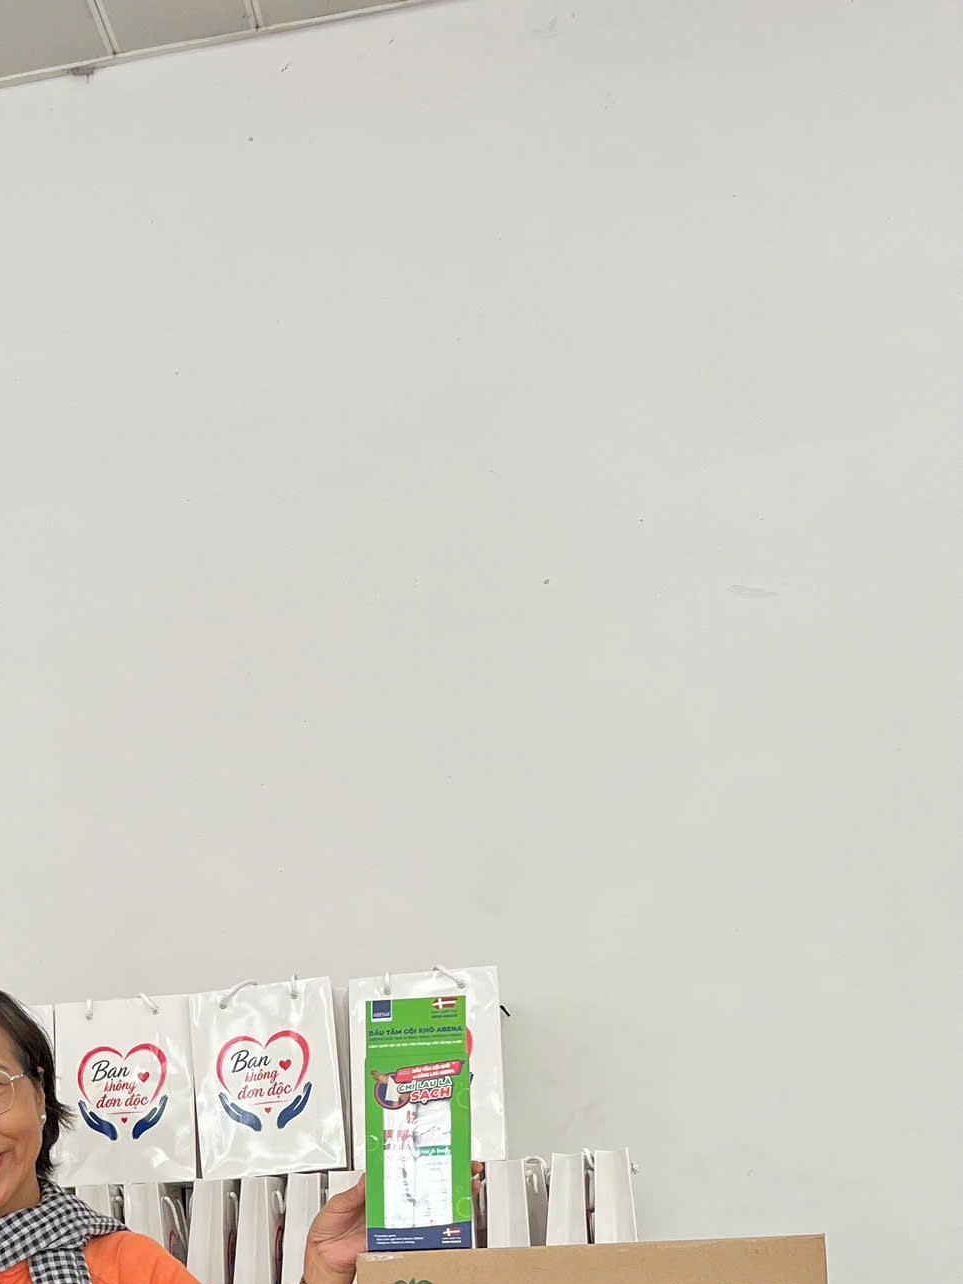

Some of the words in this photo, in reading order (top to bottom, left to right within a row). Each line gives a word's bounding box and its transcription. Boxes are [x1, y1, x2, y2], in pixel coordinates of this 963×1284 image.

[231, 1049, 271, 1073] Bạn
[92, 1060, 131, 1082] Bạn
[245, 1070, 279, 1083] không
[104, 1080, 136, 1094] không
[238, 1085, 264, 1100] đơn
[267, 1083, 292, 1098] độc
[410, 1087, 450, 1102] SẠCH
[96, 1095, 121, 1108] đơn
[125, 1094, 149, 1109] độc
